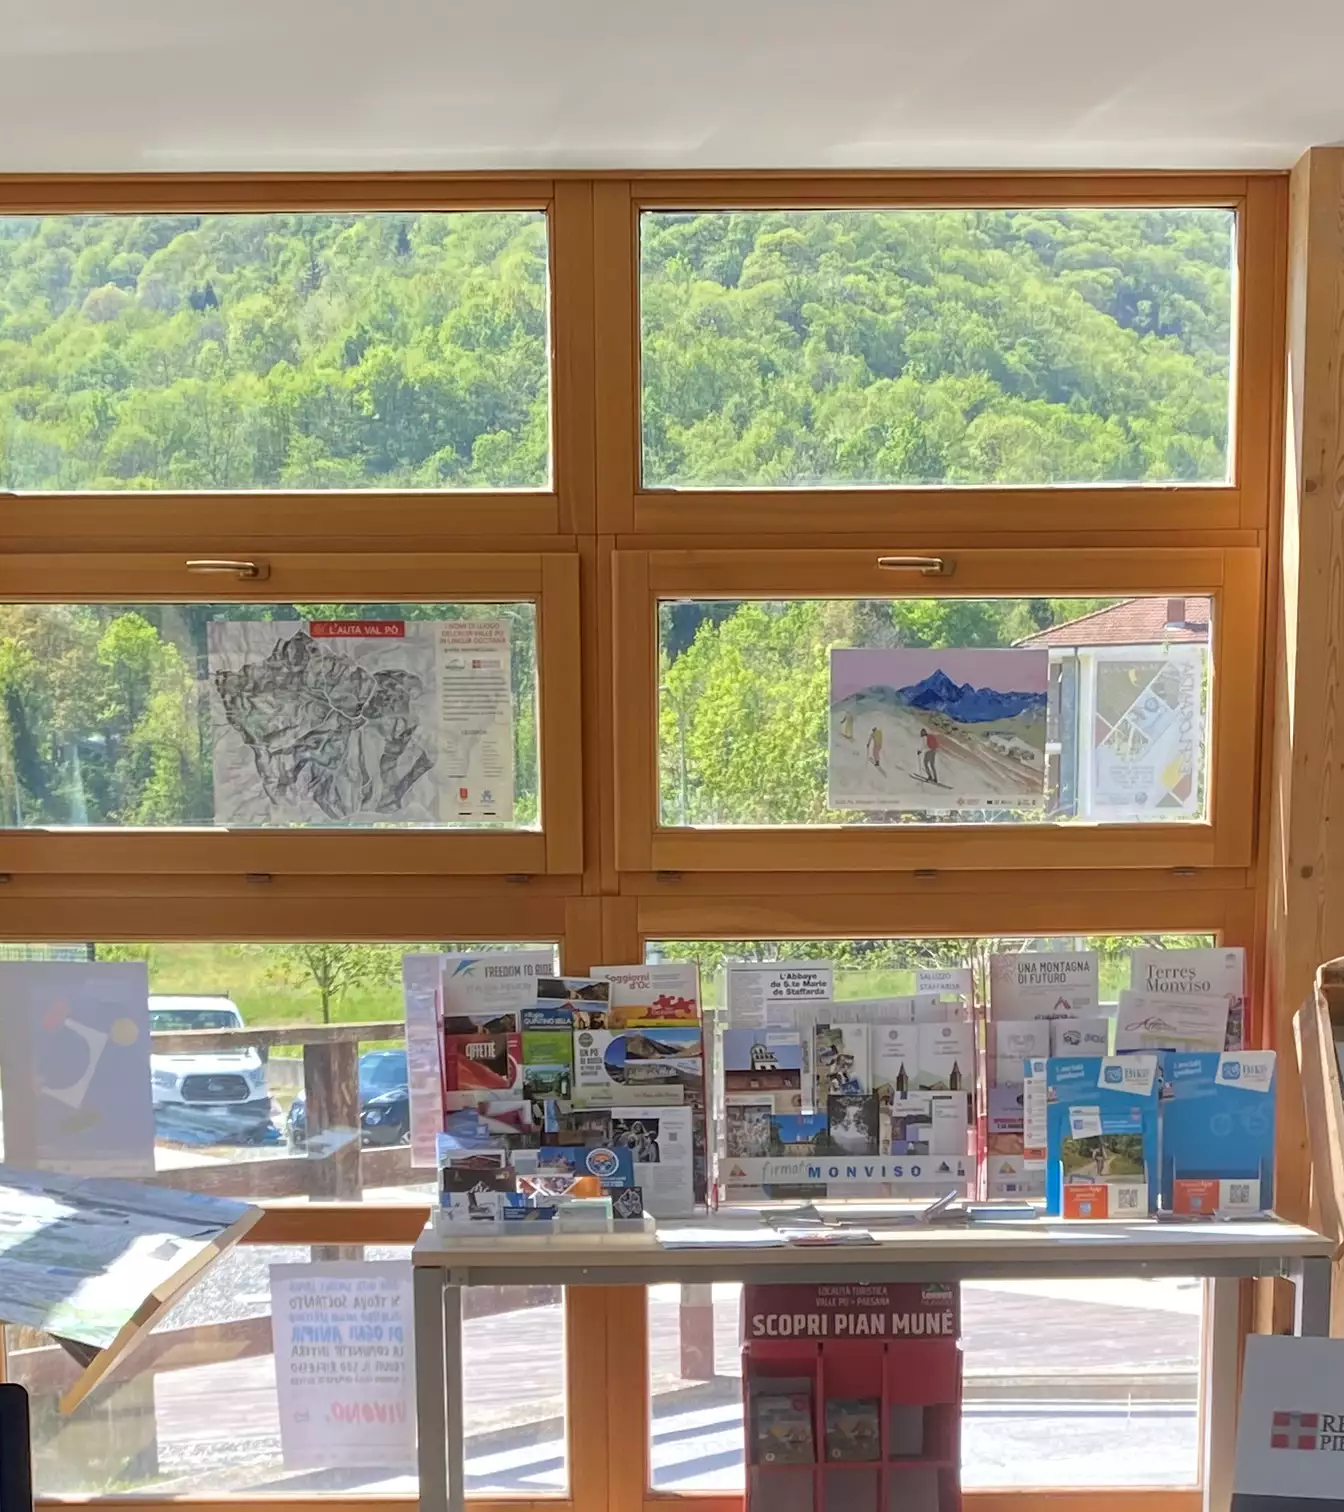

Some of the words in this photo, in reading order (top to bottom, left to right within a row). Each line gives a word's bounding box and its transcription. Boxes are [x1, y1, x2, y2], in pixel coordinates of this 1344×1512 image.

[329, 625, 361, 634] L'AUTA
[485, 964, 520, 978] FREEDOM
[524, 964, 533, 976] TO
[1018, 962, 1037, 972] UNA
[1039, 961, 1090, 972] MONTAGNA
[1148, 965, 1196, 979] Terres
[780, 973, 817, 982] L'Abbaye
[1018, 974, 1027, 984] DI
[1029, 973, 1066, 984] FUTURO
[1146, 977, 1211, 992] Monviso
[808, 1166, 921, 1178] MONVISO
[752, 1314, 827, 1336] SCOPRI
[835, 1314, 885, 1335] PIAN
[893, 1308, 954, 1335] MUNÉ
